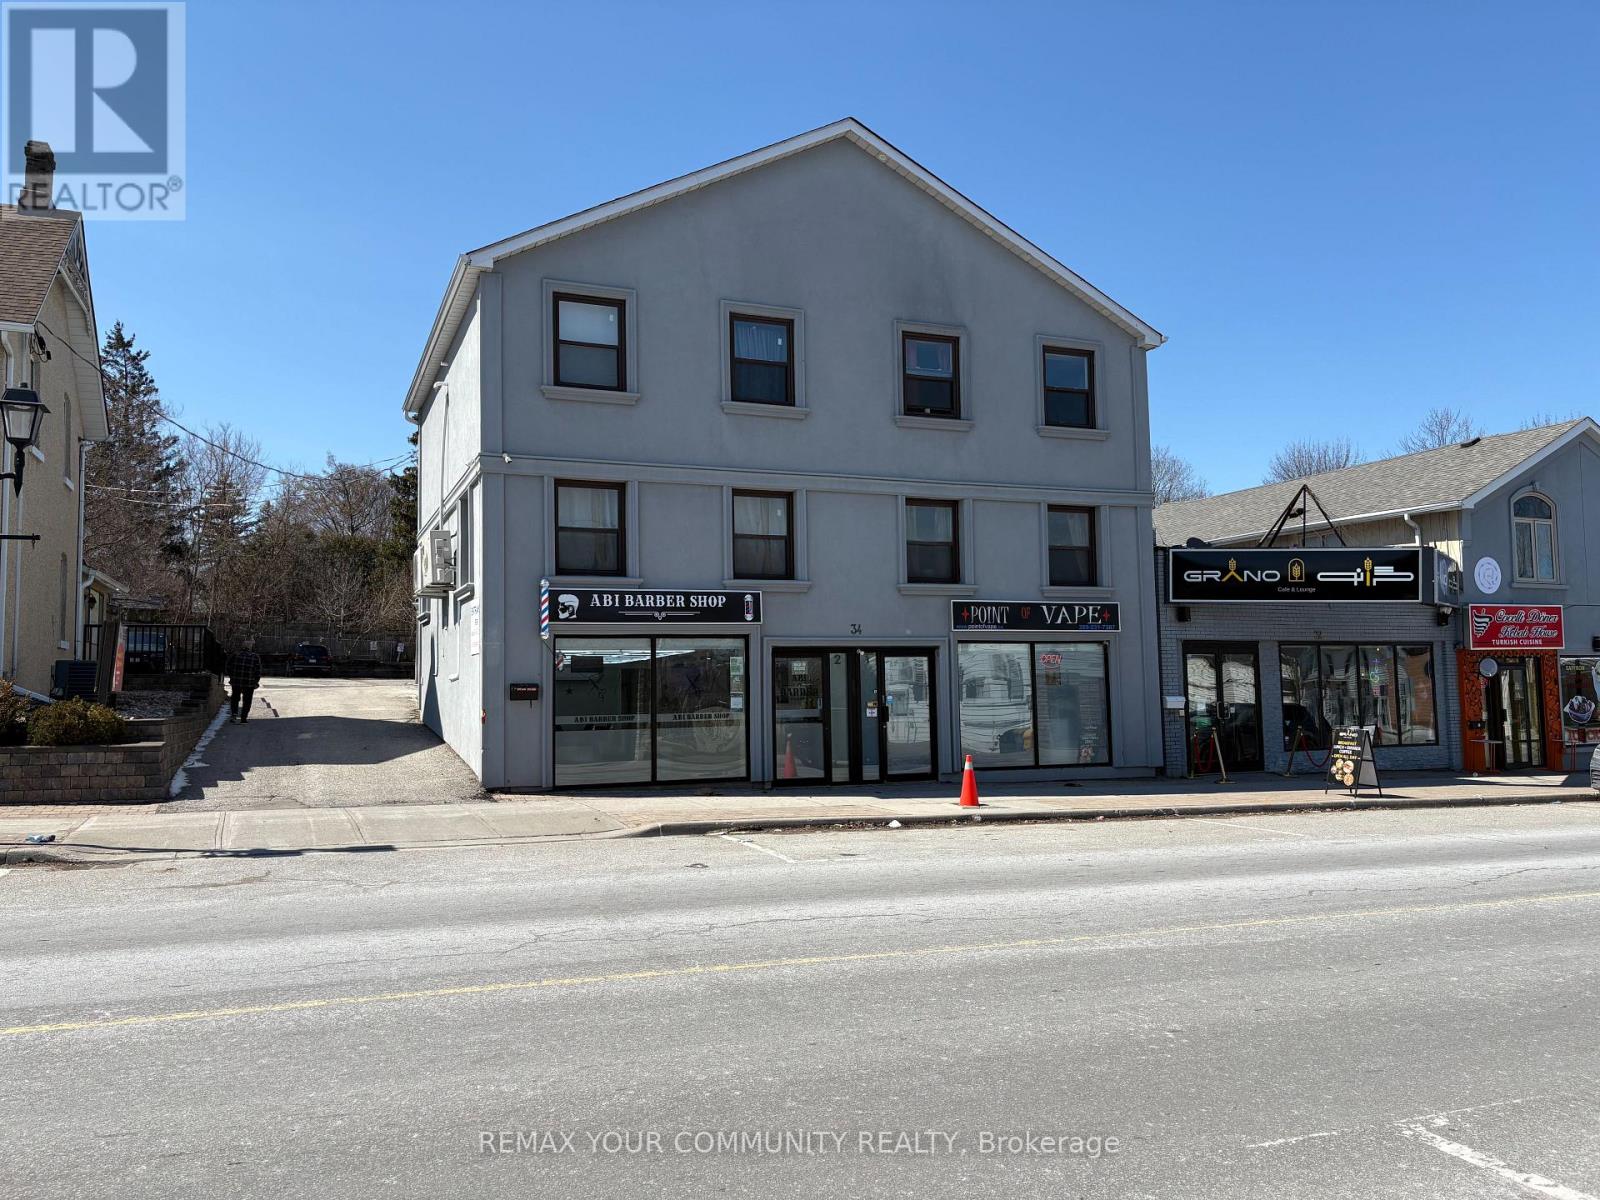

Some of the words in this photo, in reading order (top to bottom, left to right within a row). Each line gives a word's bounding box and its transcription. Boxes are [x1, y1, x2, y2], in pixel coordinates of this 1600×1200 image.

[590, 593, 620, 607] ABI
[624, 594, 686, 608] BARBER
[690, 595, 727, 608] SHOP
[970, 605, 1010, 624] POINT
[1021, 606, 1032, 619] OF
[1040, 605, 1102, 624] VAPE
[850, 624, 863, 635] 34
[1498, 624, 1529, 638] Kebab
[1529, 624, 1558, 638] House
[834, 655, 841, 664] 2
[1040, 654, 1062, 665] OPEN
